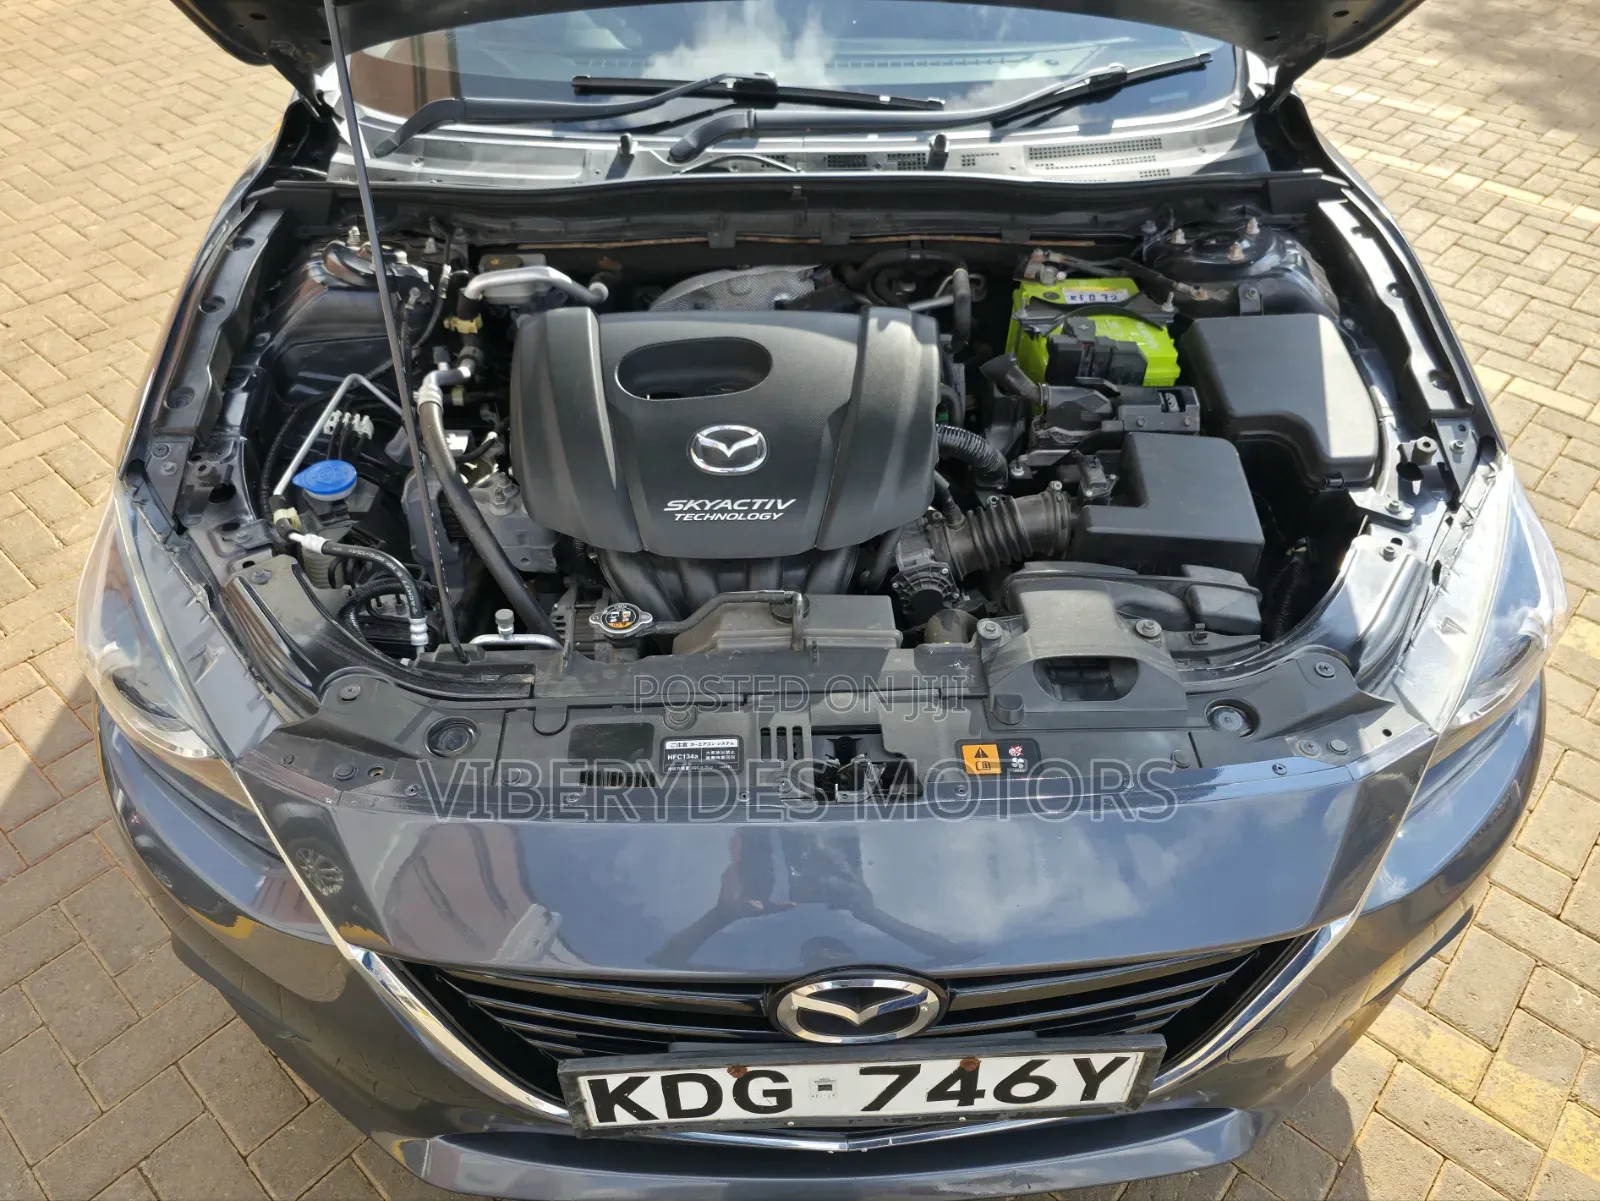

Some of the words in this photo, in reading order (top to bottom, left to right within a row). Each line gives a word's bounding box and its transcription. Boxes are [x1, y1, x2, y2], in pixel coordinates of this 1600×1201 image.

[663, 498, 797, 511] SKYACTIV
[674, 512, 784, 521] TECHNOLOGY
[598, 1068, 793, 1123] KDG
[858, 1056, 1131, 1112] 746Y
